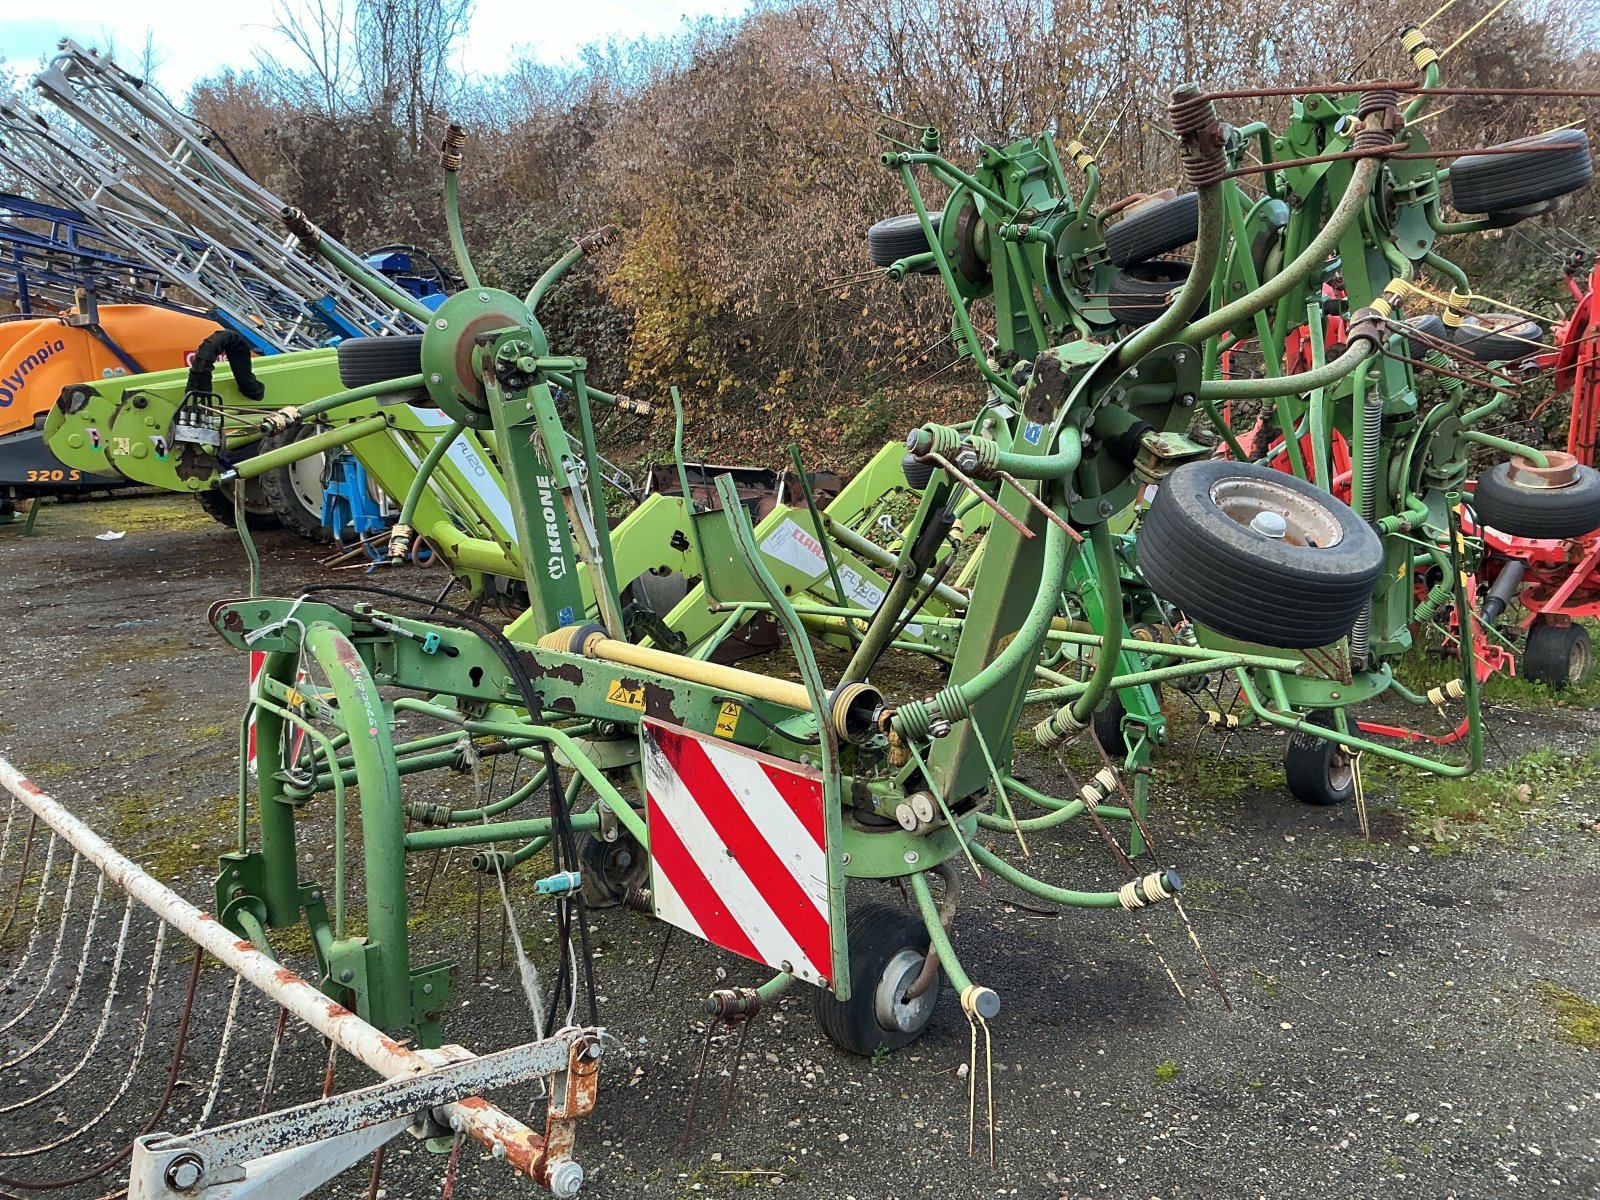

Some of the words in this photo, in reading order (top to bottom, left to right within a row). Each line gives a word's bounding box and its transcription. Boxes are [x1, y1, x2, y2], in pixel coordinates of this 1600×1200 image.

[0, 339, 65, 408] Olympia
[26, 469, 64, 482] 320
[69, 469, 81, 481] S
[457, 442, 468, 455] FL
[466, 453, 486, 477] 120
[536, 475, 563, 553] KRONE
